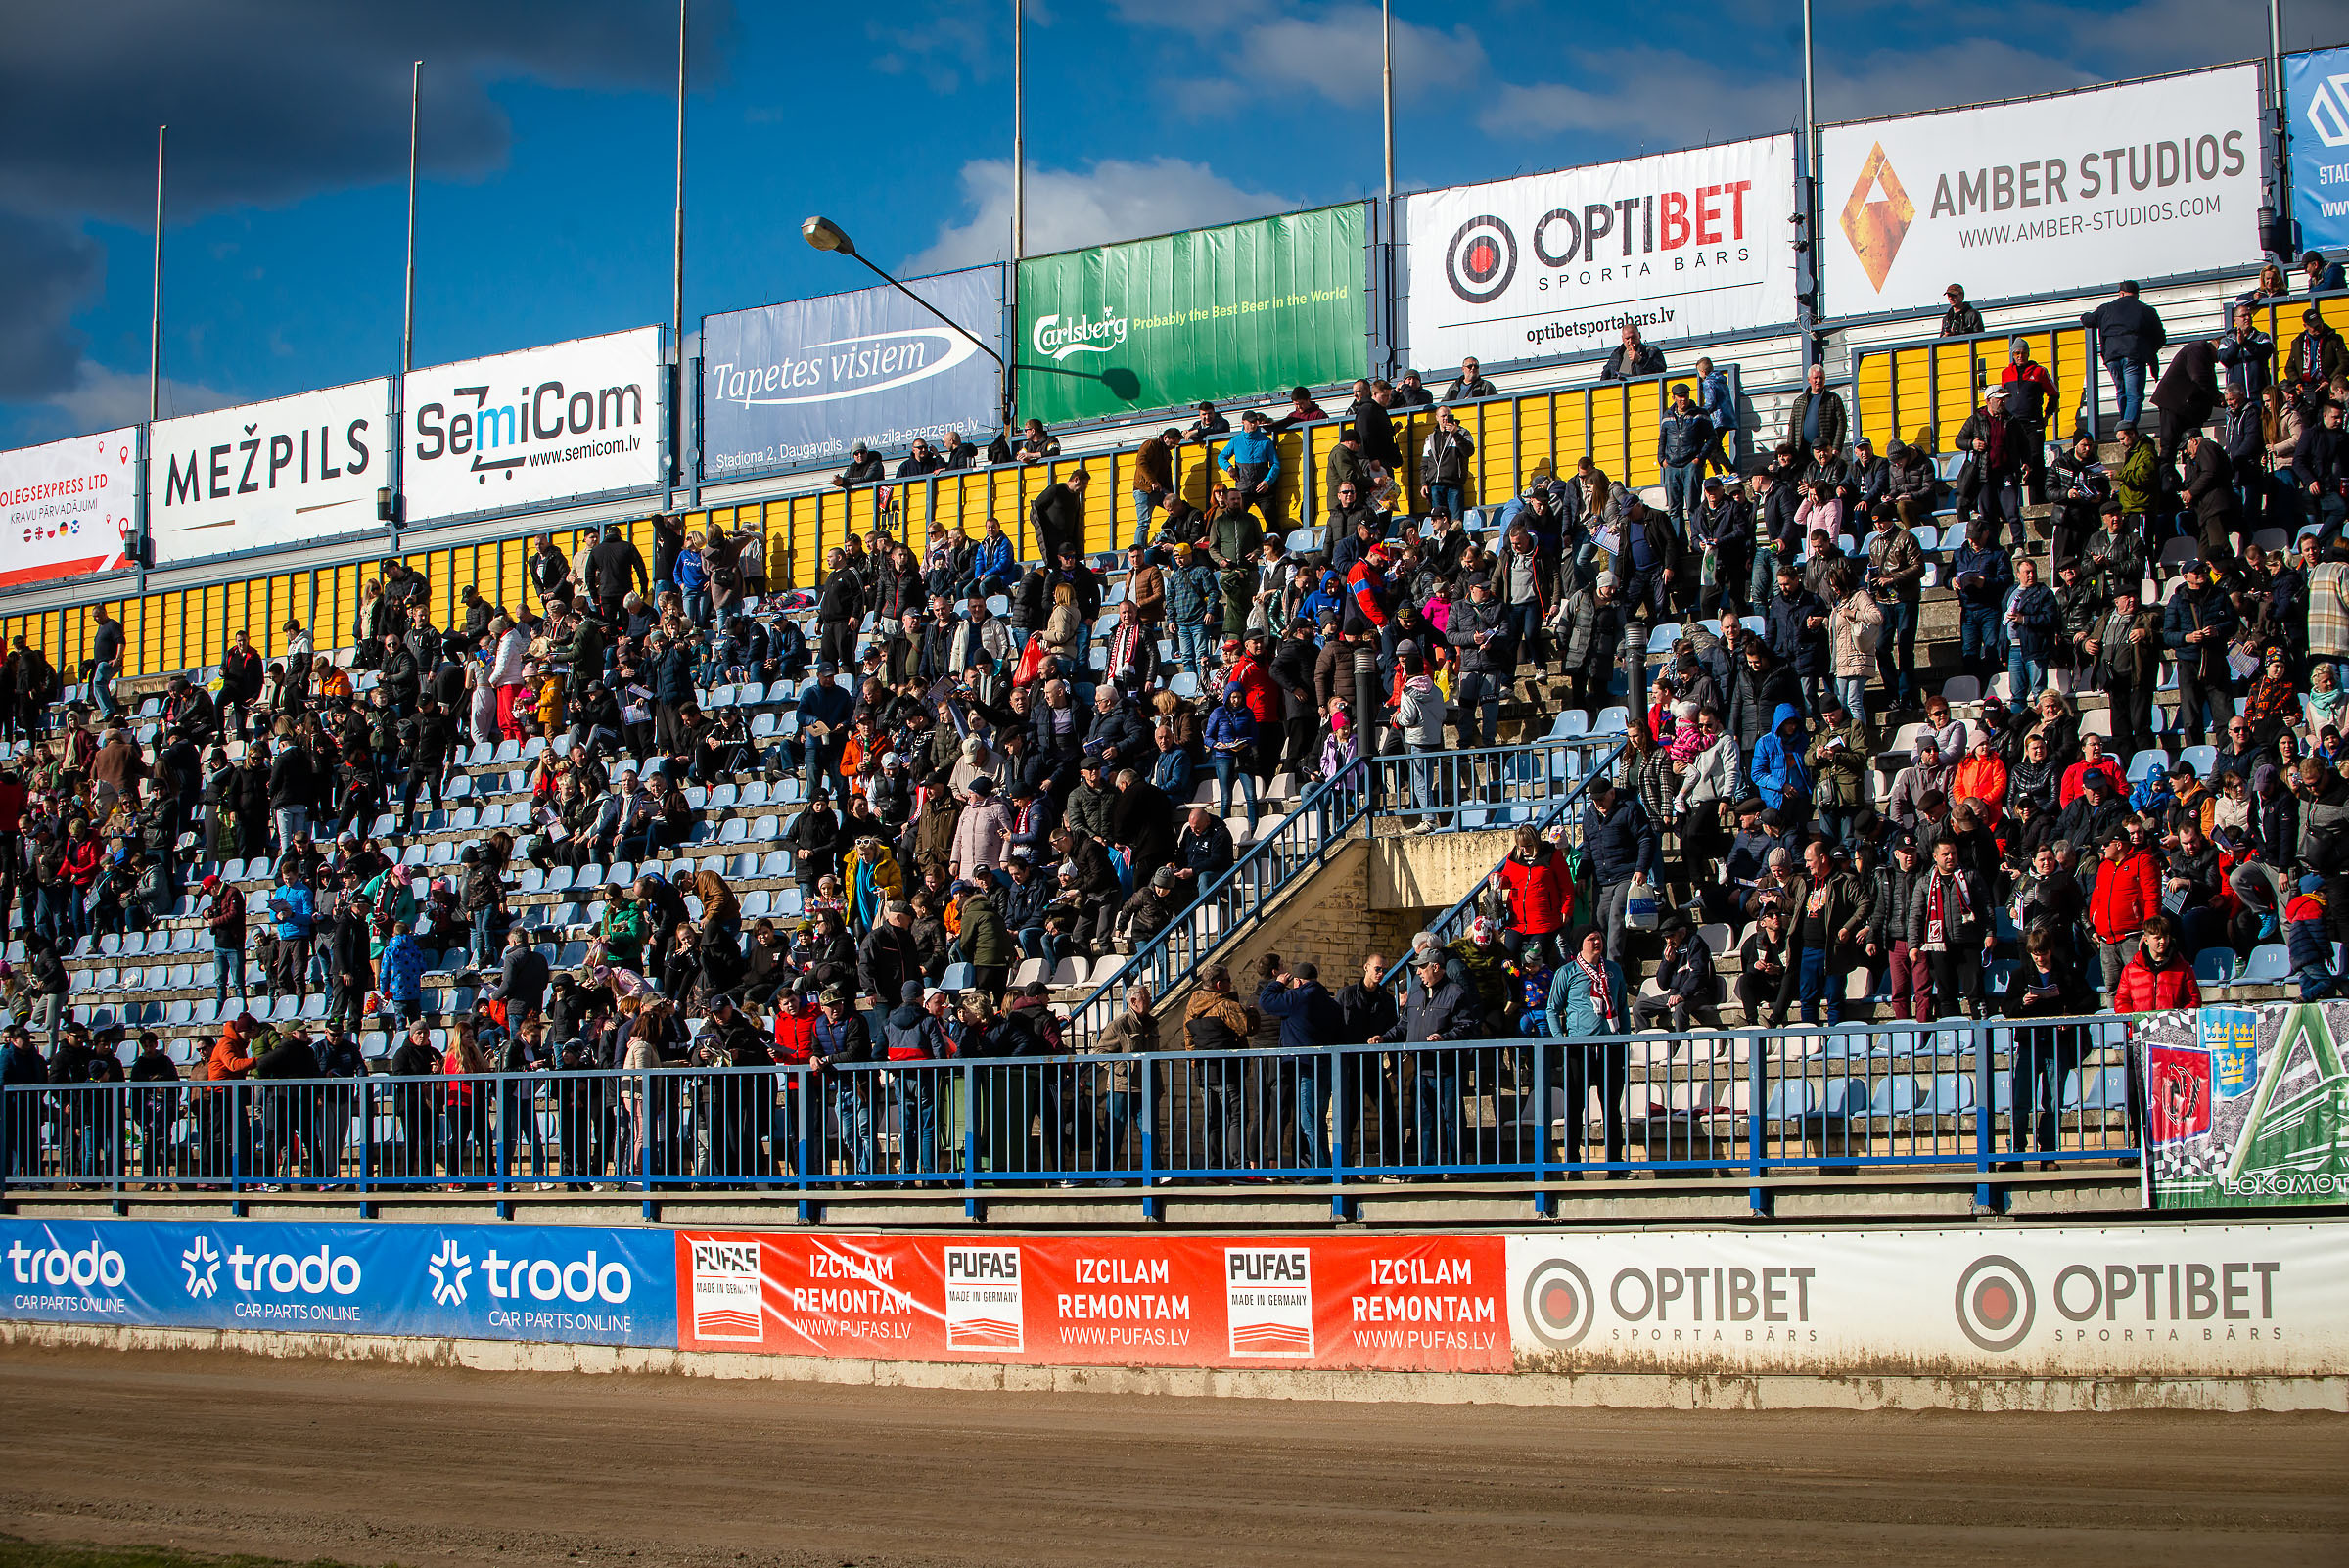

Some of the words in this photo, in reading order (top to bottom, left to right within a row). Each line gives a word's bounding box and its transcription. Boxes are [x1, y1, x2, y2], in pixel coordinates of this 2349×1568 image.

[1930, 158, 2068, 219] AMBER
[2079, 130, 2245, 199] STUDIOS
[1534, 180, 1751, 268] OPTIBET
[1959, 195, 2221, 249] WWW.AMBER-STUDIOS.COM
[1539, 262, 1650, 291] SPORTA
[1675, 248, 1749, 271] BĀRS
[1133, 310, 1185, 330] Probably
[1189, 307, 1209, 322] the
[1212, 303, 1238, 318] Best
[1241, 300, 1269, 314] Beer
[1272, 296, 1283, 309] in
[1286, 293, 1307, 306] the
[1310, 285, 1348, 302] World
[1033, 306, 1128, 361] Carlsberg
[1527, 307, 1675, 345] optibetsportabars.lv
[714, 357, 822, 410] Tapetes
[831, 341, 925, 382] visiem
[416, 381, 642, 460] SemiCom
[165, 420, 370, 507] MEŽPILS
[530, 435, 641, 468] www.semicom.lv
[716, 449, 763, 469] Stadiona
[767, 446, 777, 461] 2,
[780, 438, 843, 460] Daugavpils
[0, 477, 84, 507] OLEGSEXPRESS
[89, 474, 108, 490] LTD
[11, 509, 37, 525] KRAVU
[39, 497, 98, 519] PĀRVADĀJUMI
[2107, 1078, 2118, 1086] 12
[7, 1240, 126, 1287] trodo
[227, 1244, 361, 1294] trodo
[695, 1246, 758, 1272] PUFAS
[809, 1254, 894, 1280] IZCILAM
[949, 1252, 1017, 1278] PUFAS
[1075, 1259, 1169, 1283] IZCILAM
[1229, 1254, 1305, 1280] PUFAS
[1371, 1259, 1471, 1285] IZCILAM
[480, 1249, 632, 1304] trodo
[696, 1283, 715, 1294] MADE
[716, 1283, 724, 1294] IN
[15, 1295, 39, 1310] CAR
[40, 1295, 78, 1312] PARTS
[80, 1297, 125, 1313] ONLINE
[794, 1288, 911, 1314] REMONTAM
[949, 1291, 970, 1302] MADE
[972, 1291, 981, 1302] IN
[983, 1291, 1018, 1303] GERMANY
[1231, 1294, 1254, 1306] MADE
[1257, 1294, 1265, 1306] IN
[1267, 1294, 1307, 1307] GERMANY
[1610, 1267, 1816, 1322] OPTIBET
[2053, 1262, 2280, 1321] OPTIBET
[235, 1303, 262, 1317] CAR
[265, 1304, 308, 1319] PARTS
[310, 1305, 361, 1321] ONLINE
[1057, 1294, 1190, 1320] REMONTAM
[1352, 1296, 1495, 1322] REMONTAM
[488, 1311, 521, 1327] CAR
[525, 1312, 573, 1329] PARTS
[576, 1314, 631, 1332] ONLINE
[796, 1318, 911, 1339] WWW.PUFAS.LV
[1612, 1329, 1723, 1341] SPORTA
[1745, 1326, 1818, 1342] BĀRS
[2054, 1328, 2179, 1341] SPORTA
[2203, 1325, 2281, 1340] BĀRS
[1060, 1326, 1190, 1346] WWW.PUFAS.LV
[1353, 1330, 1496, 1350] WWW.PUFAS.LV
